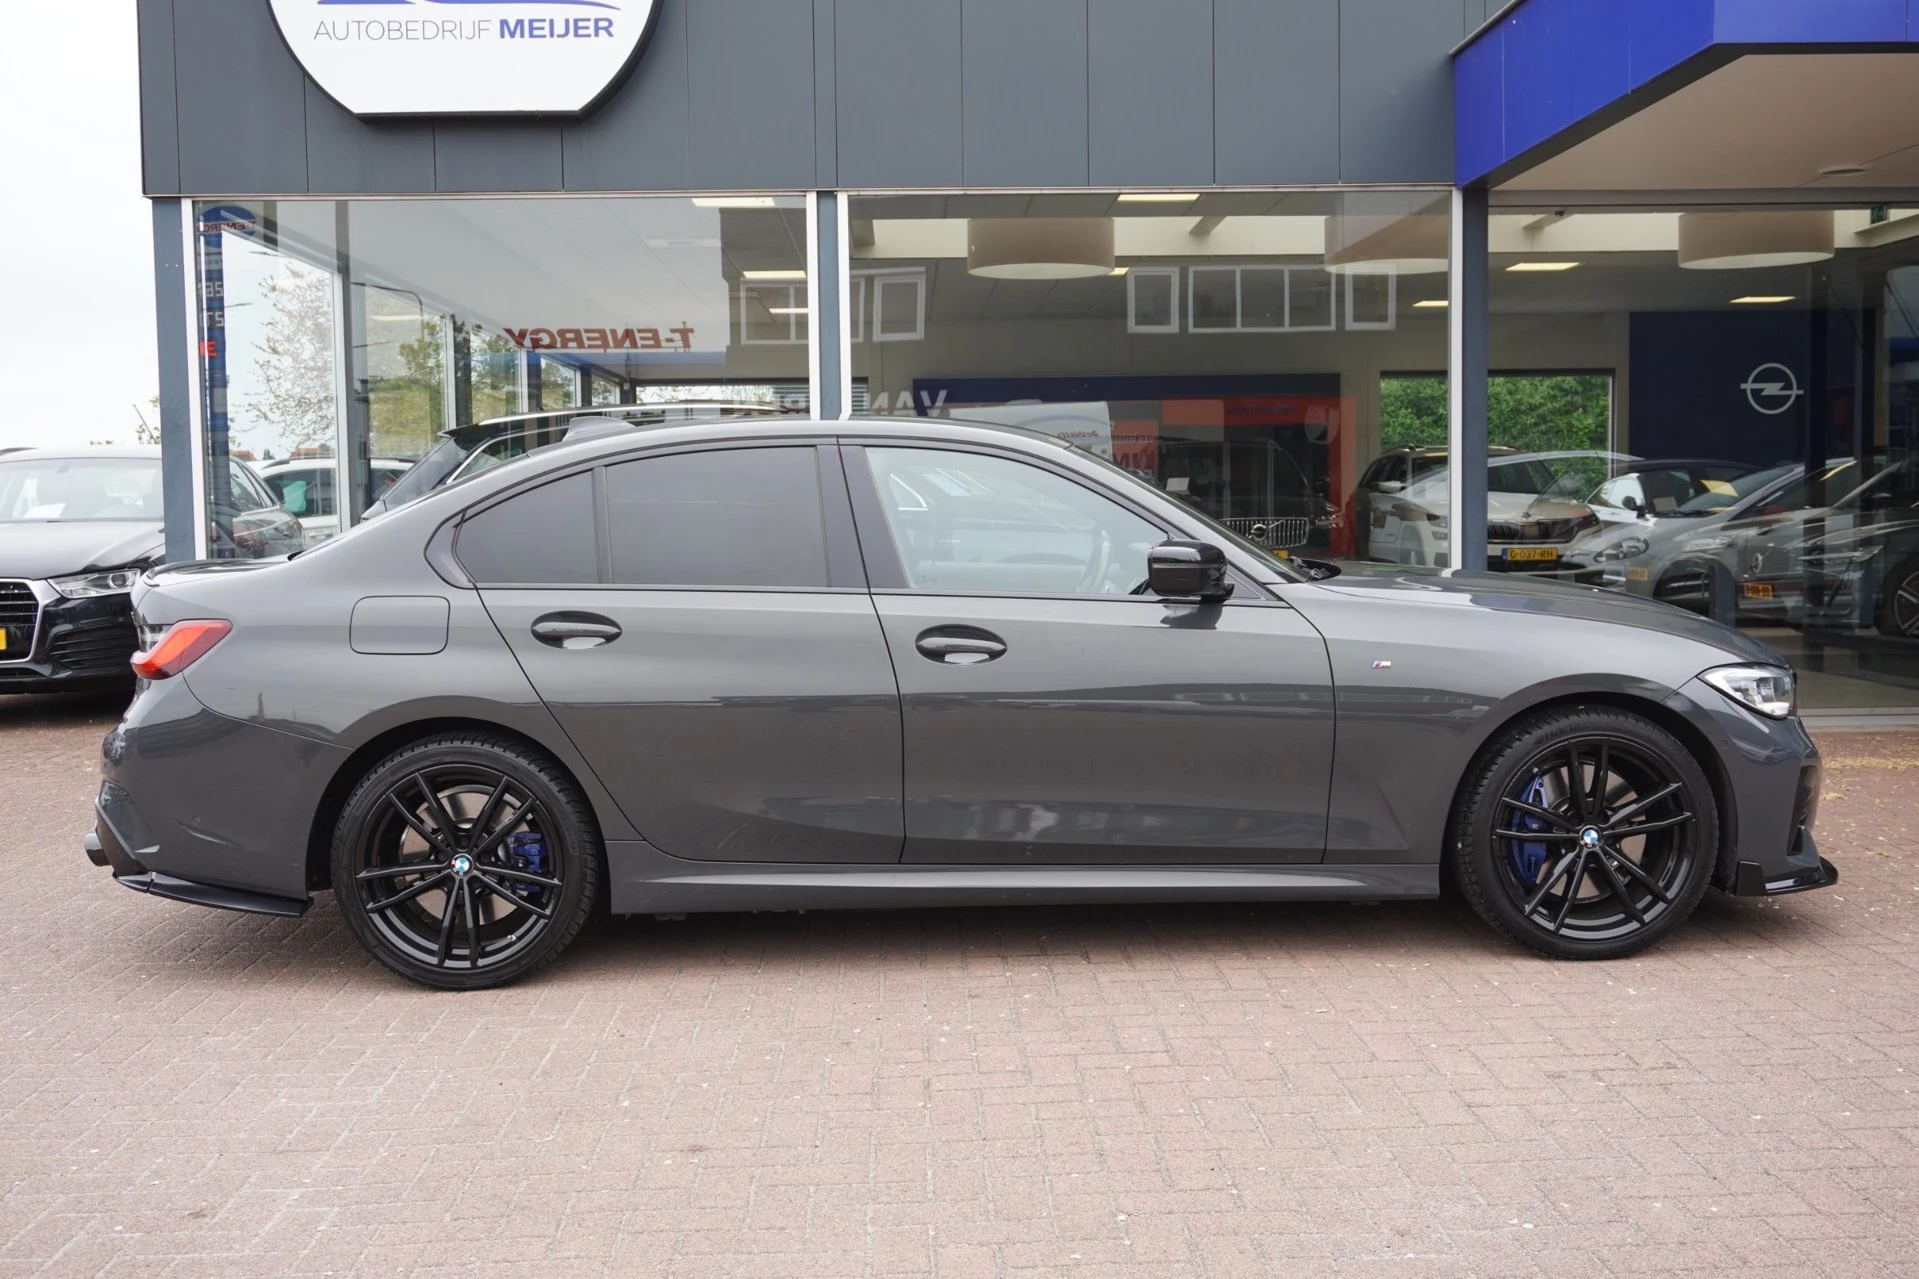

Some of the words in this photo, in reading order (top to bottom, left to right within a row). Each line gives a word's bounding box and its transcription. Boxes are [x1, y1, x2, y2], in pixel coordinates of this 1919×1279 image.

[313, 20, 492, 41] AUTOBEDRIJF
[499, 17, 615, 39] MEIJER
[1509, 550, 1554, 559] G-037-RH
